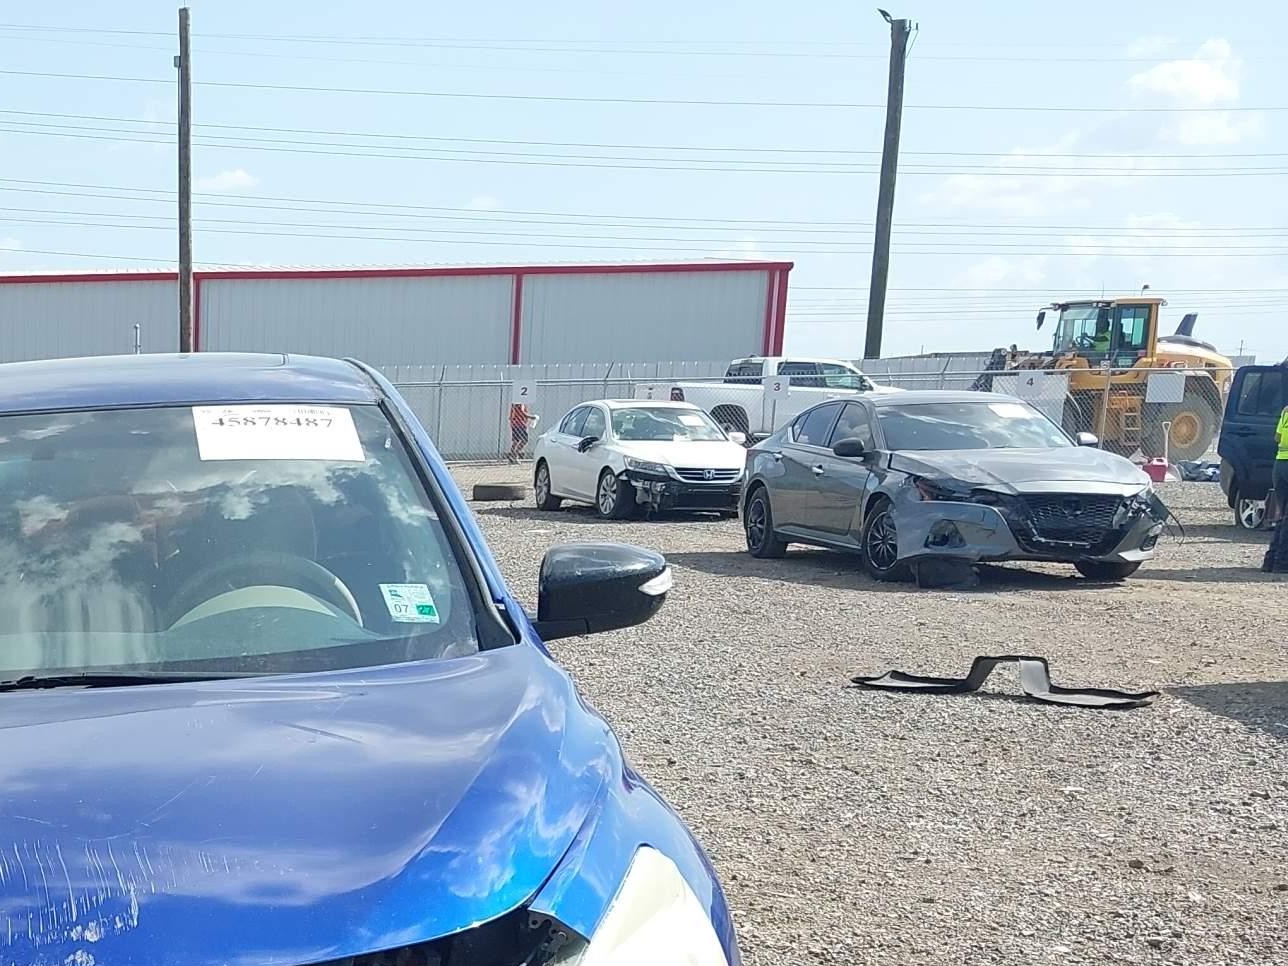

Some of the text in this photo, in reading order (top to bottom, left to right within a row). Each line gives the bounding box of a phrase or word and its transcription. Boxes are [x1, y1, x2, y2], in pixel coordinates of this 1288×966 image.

[773, 382, 781, 391] 3
[1026, 377, 1034, 386] 4
[520, 386, 528, 396] 2
[211, 416, 333, 428] 45878487
[394, 603, 409, 614] 07
[416, 604, 433, 616] 27
